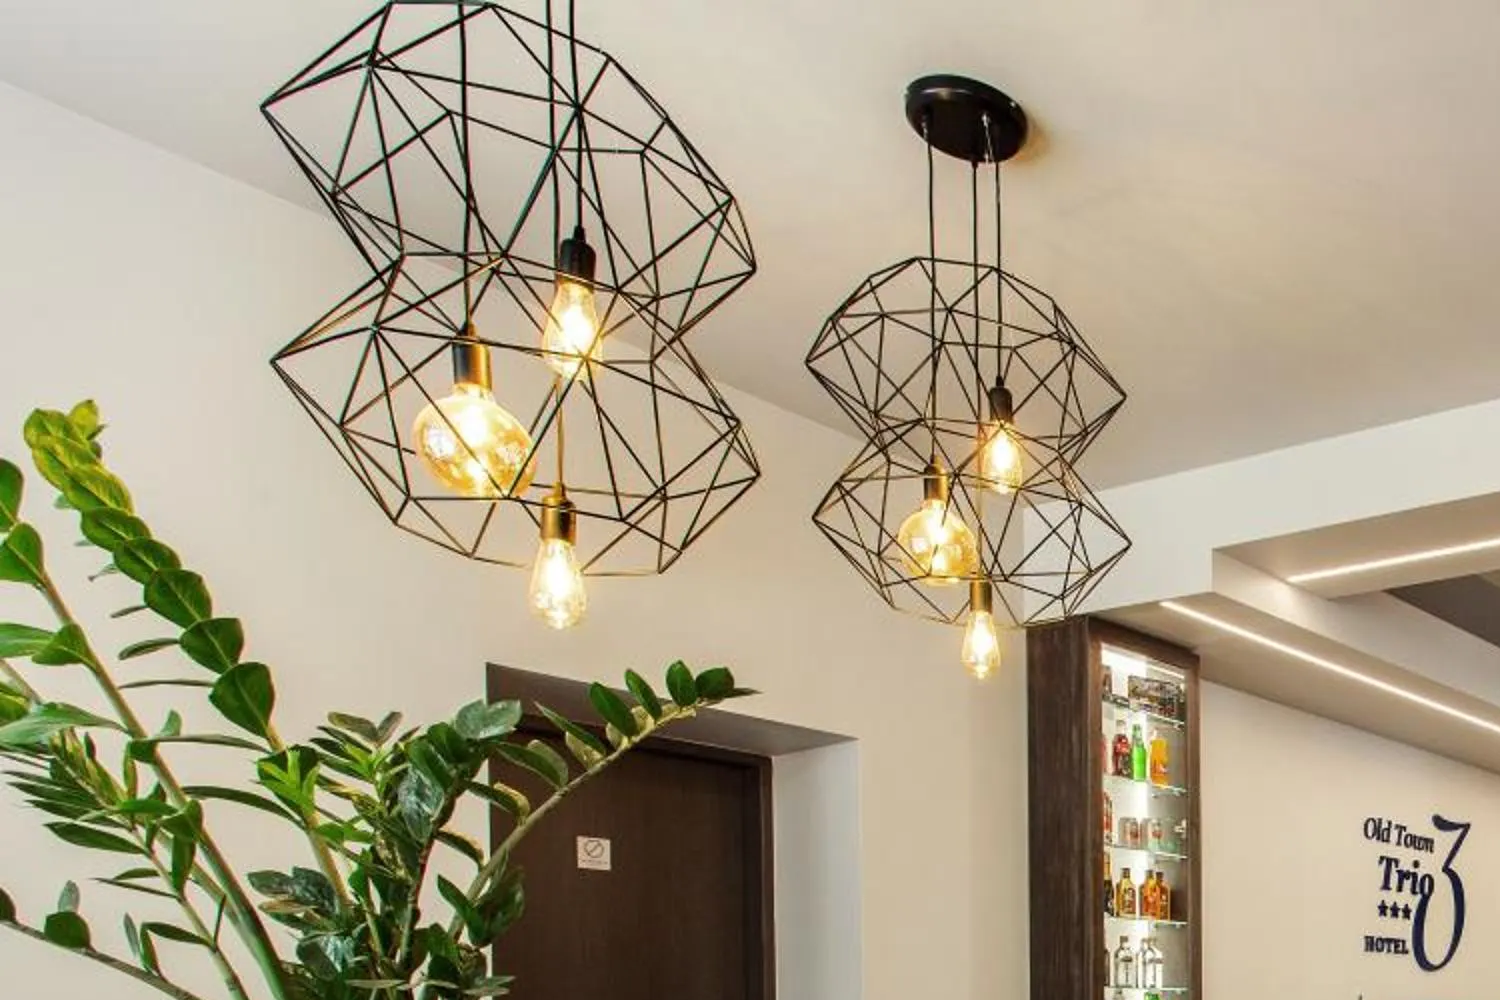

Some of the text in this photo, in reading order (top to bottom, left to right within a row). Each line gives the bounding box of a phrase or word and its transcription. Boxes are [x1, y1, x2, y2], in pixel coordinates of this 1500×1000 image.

[1363, 817, 1435, 853] Old Town
[1378, 855, 1435, 896] Trio
[1364, 936, 1409, 954] HOTEL
